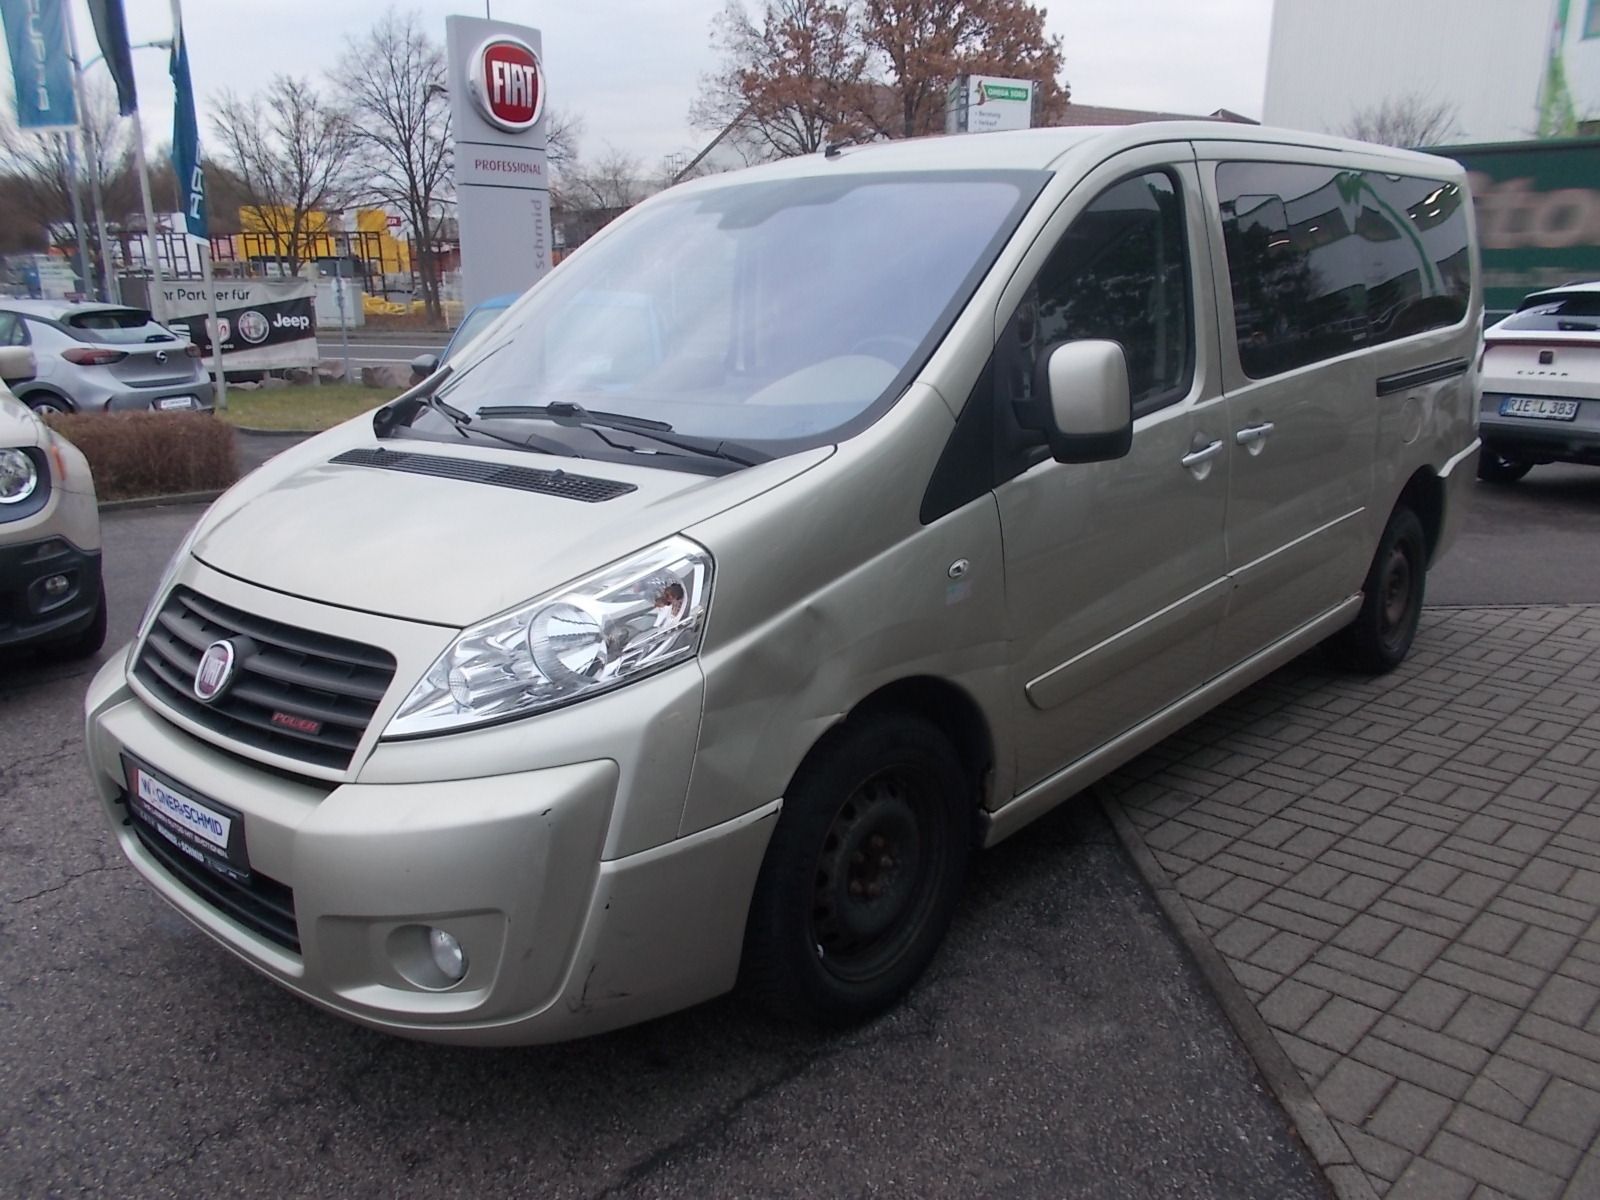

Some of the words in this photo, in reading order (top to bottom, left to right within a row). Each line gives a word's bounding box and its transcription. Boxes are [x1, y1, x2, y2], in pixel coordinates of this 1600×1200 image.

[491, 60, 535, 108] FIAT
[474, 159, 542, 175] PROFESSIONAL
[530, 199, 545, 270] Schmid
[177, 288, 229, 301] Parter
[232, 289, 250, 300] für
[273, 312, 310, 330] Jeep
[1510, 399, 1533, 412] RIE
[1538, 401, 1547, 413] L
[1549, 402, 1576, 415] 383
[271, 712, 318, 732] POWER
